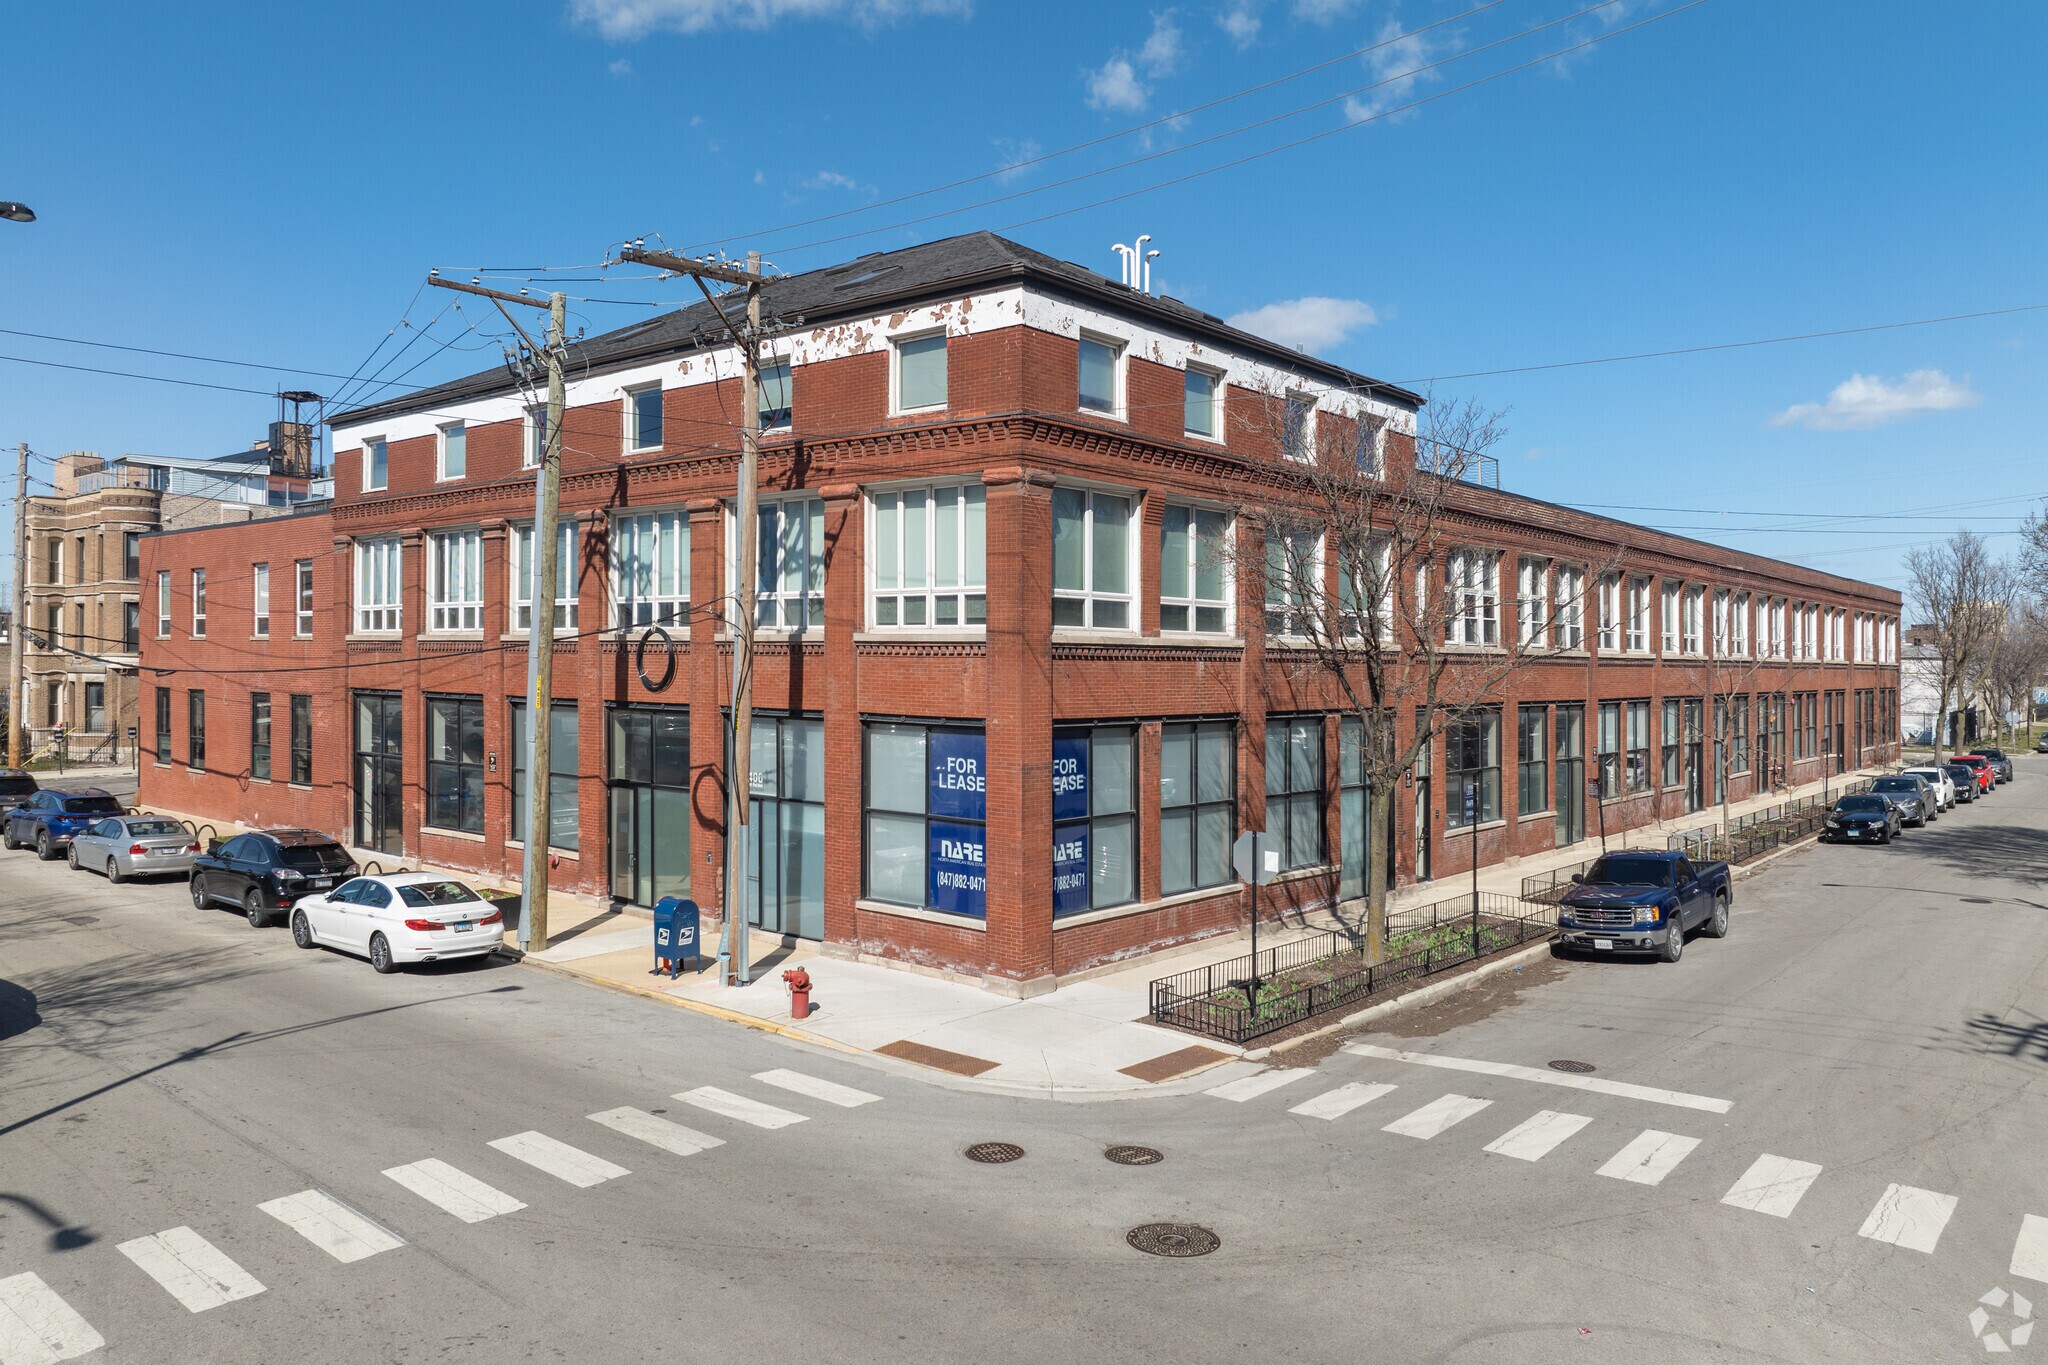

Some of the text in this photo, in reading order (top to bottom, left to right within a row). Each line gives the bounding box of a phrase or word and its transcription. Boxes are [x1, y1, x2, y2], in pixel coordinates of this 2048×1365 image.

[947, 757, 977, 774] FOR
[1053, 758, 1077, 775] FOR
[939, 773, 986, 792] LEASE
[1053, 774, 1084, 792] EASE
[937, 871, 986, 892] (847)882-0471
[1053, 872, 1085, 894] 7)882-0471
